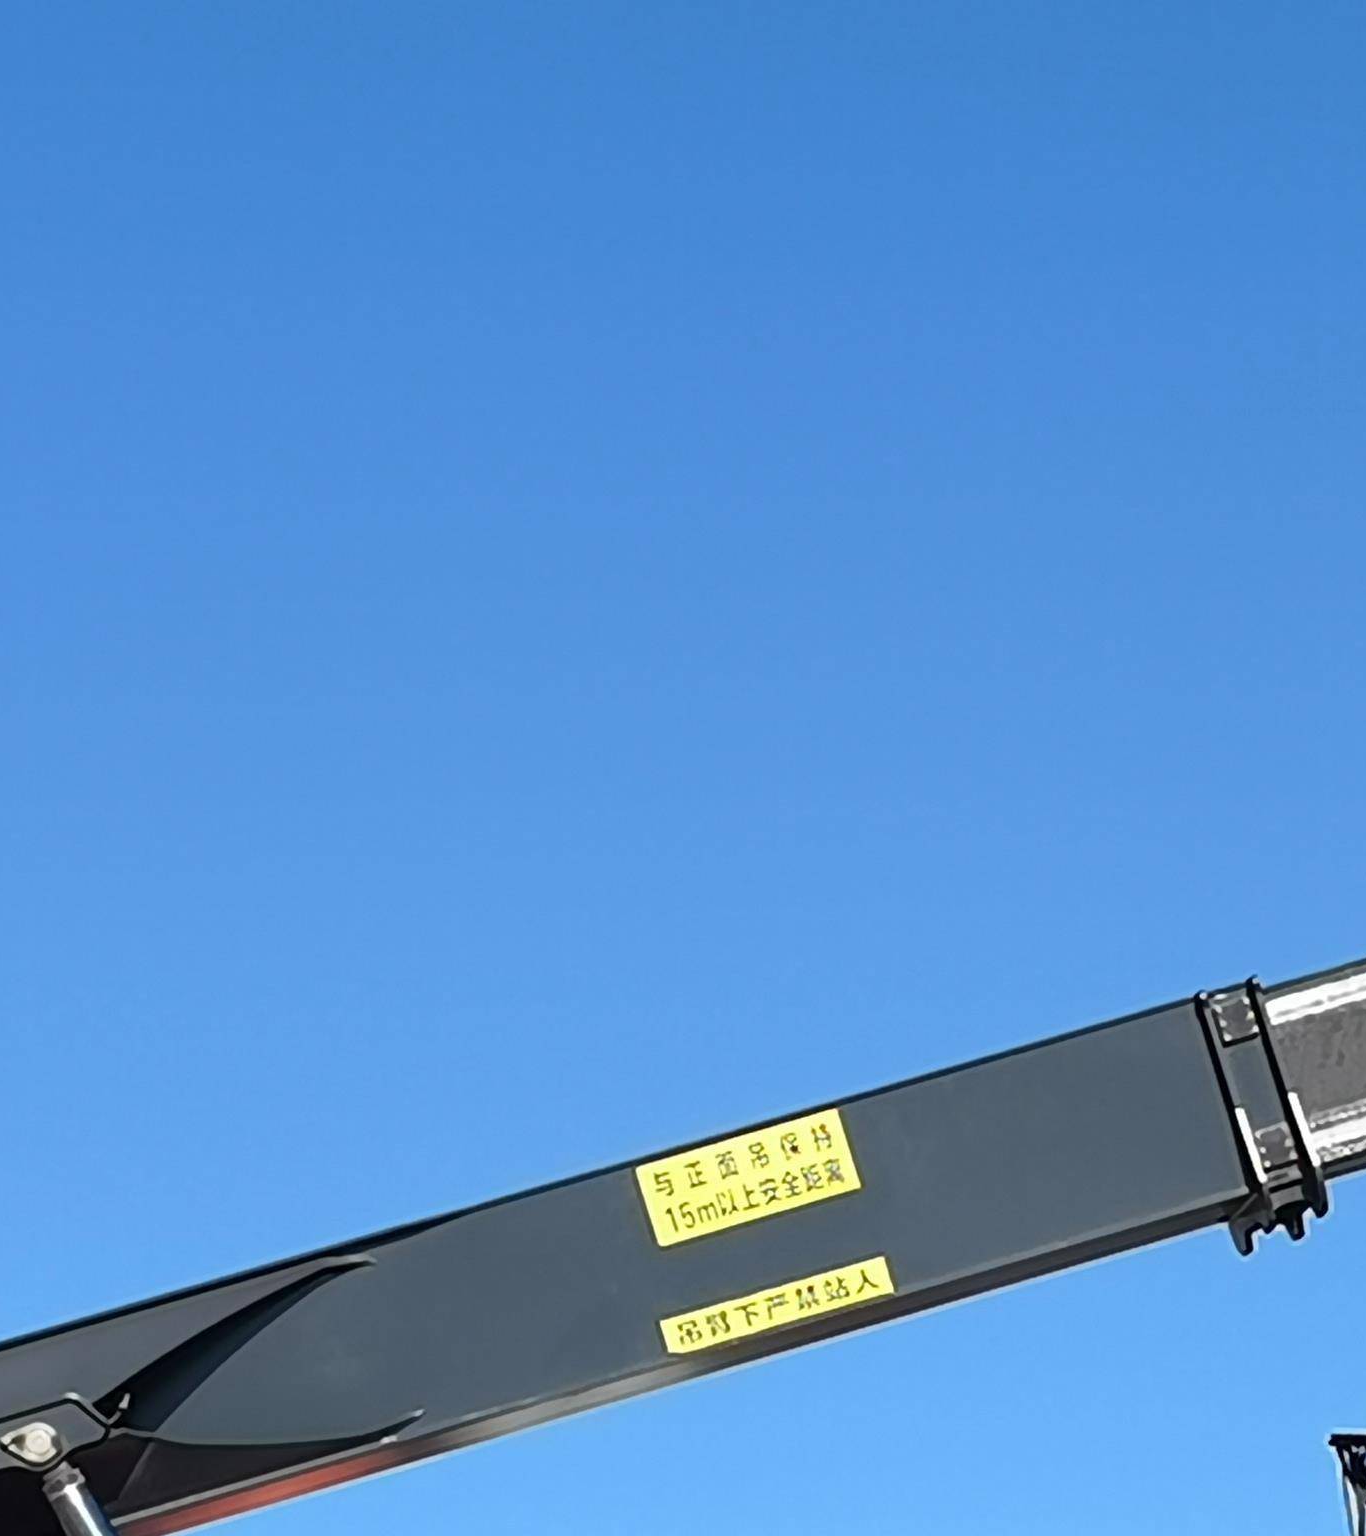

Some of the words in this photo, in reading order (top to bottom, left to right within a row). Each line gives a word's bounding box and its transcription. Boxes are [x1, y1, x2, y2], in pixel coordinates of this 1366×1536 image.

[654, 1123, 833, 1196] 与正面吊保持
[665, 1159, 846, 1233] 15m以上安全距离
